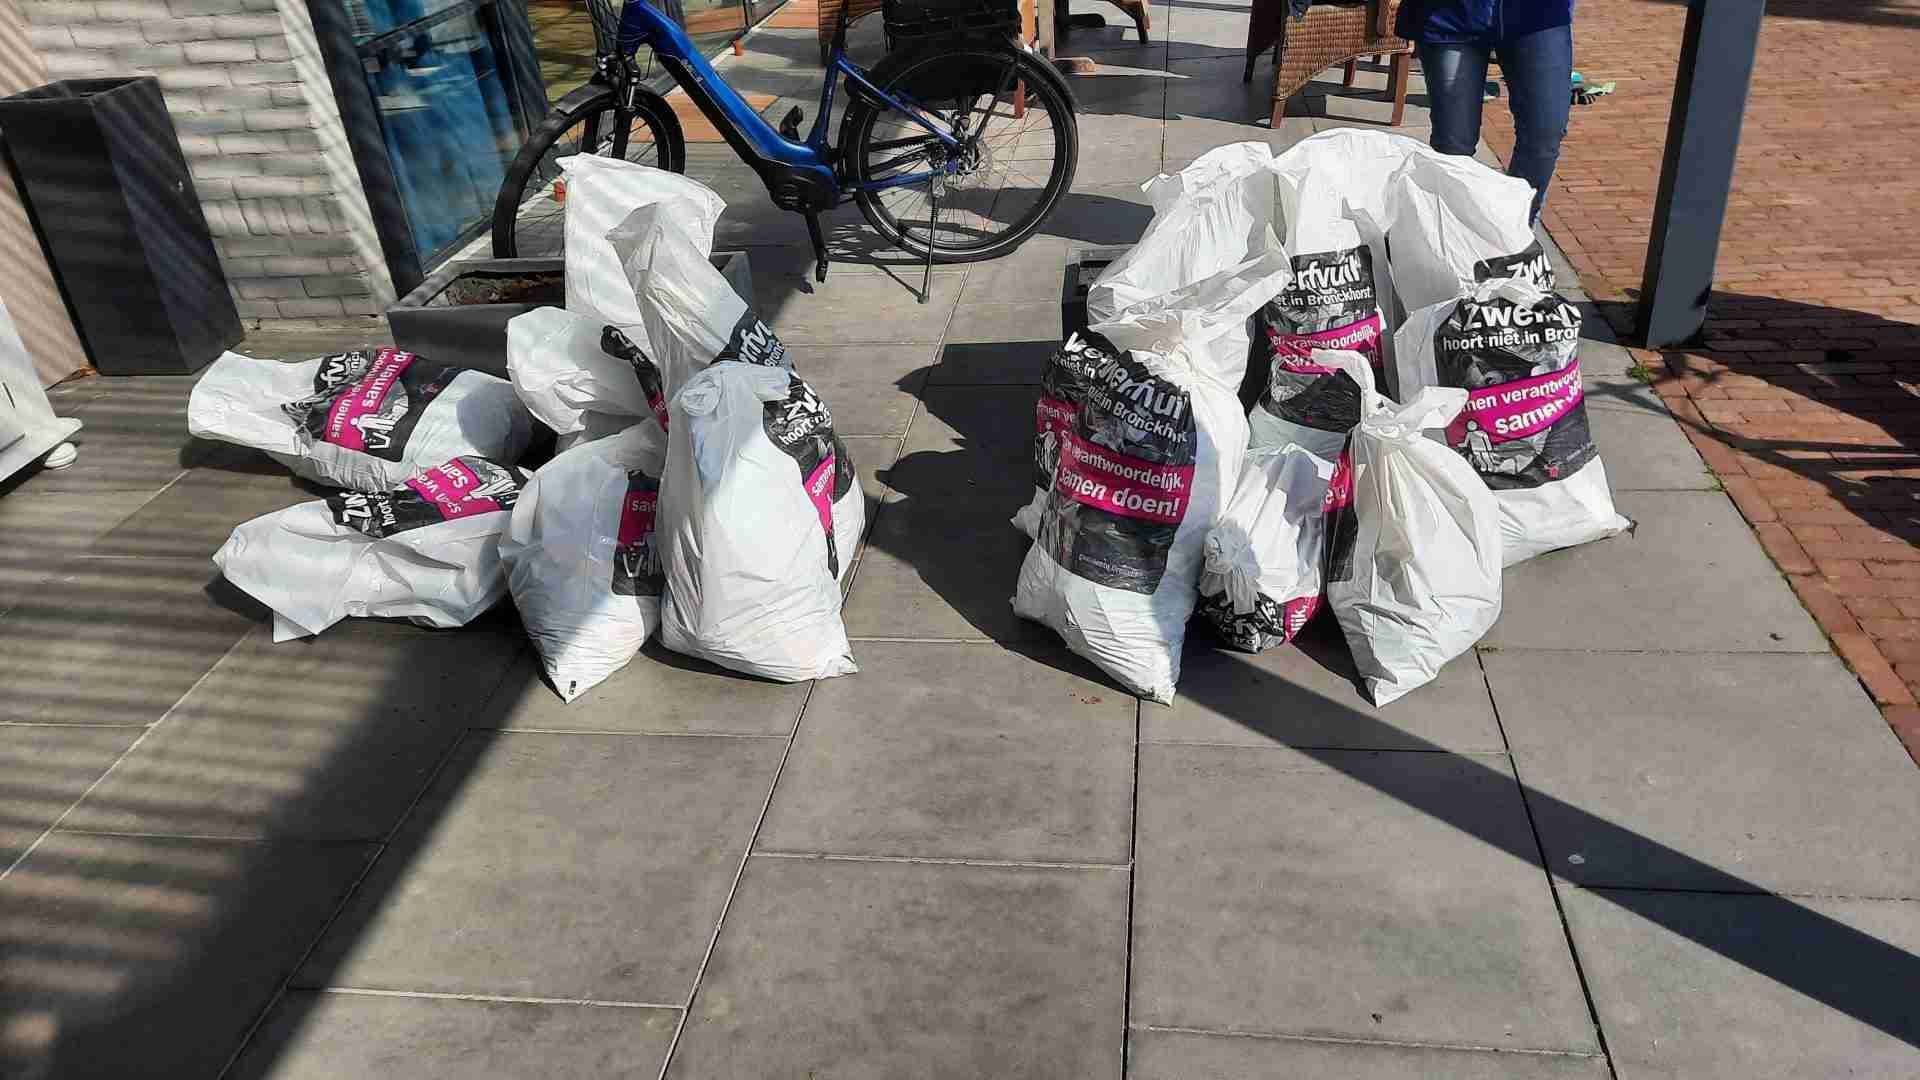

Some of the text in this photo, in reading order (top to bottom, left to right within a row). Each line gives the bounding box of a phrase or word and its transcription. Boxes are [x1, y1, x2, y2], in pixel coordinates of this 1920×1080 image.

[1443, 333, 1484, 350] hoort
[1488, 331, 1521, 348] niet
[1524, 331, 1541, 345] in
[362, 364, 399, 408] samen
[330, 398, 353, 438] samen
[778, 417, 815, 446] hoort
[1059, 466, 1180, 518] samen doen!
